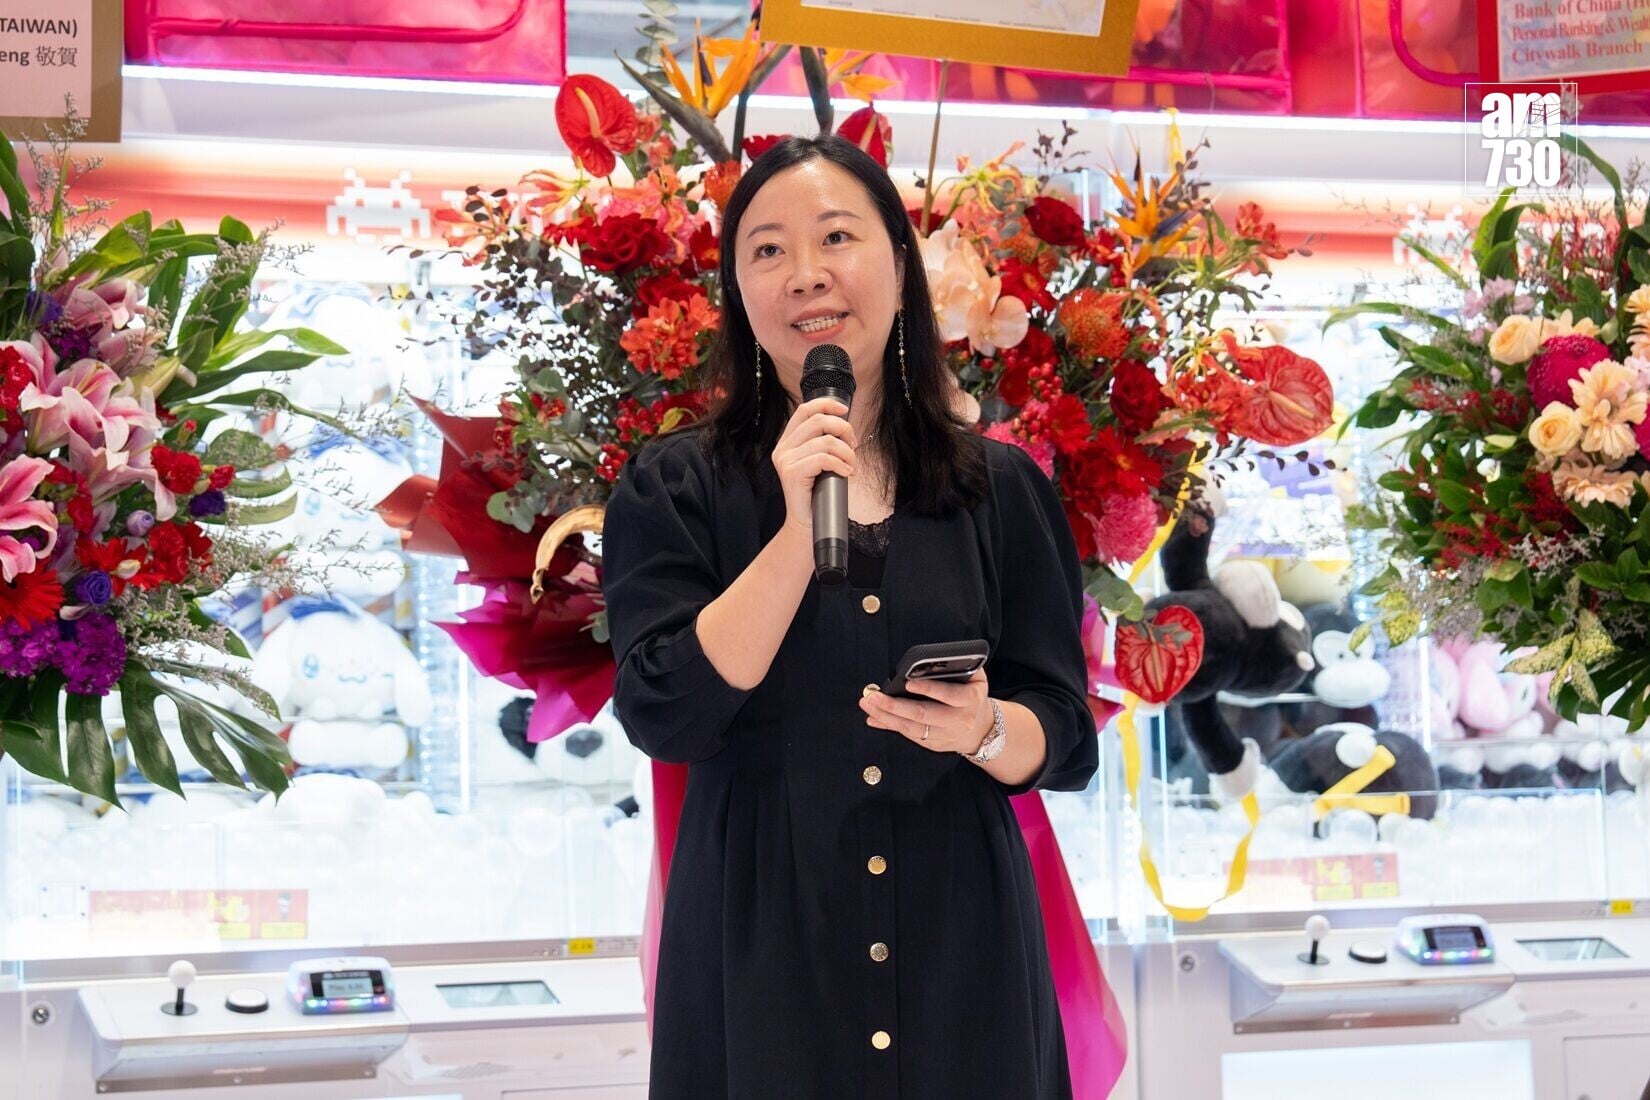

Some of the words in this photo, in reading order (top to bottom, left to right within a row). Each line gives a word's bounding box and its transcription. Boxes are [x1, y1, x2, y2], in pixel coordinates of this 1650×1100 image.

[1515, 2, 1553, 18] Bank
[1558, 0, 1572, 15] of
[1576, 0, 1621, 13] China
[0, 17, 78, 38] TAIWAN)
[1512, 22, 1557, 41] Personal
[1559, 19, 1604, 38] Banking
[1605, 18, 1616, 33] &
[35, 46, 78, 67] 敬賀
[1512, 43, 1581, 65] Citywalk
[1586, 39, 1642, 57] Branch
